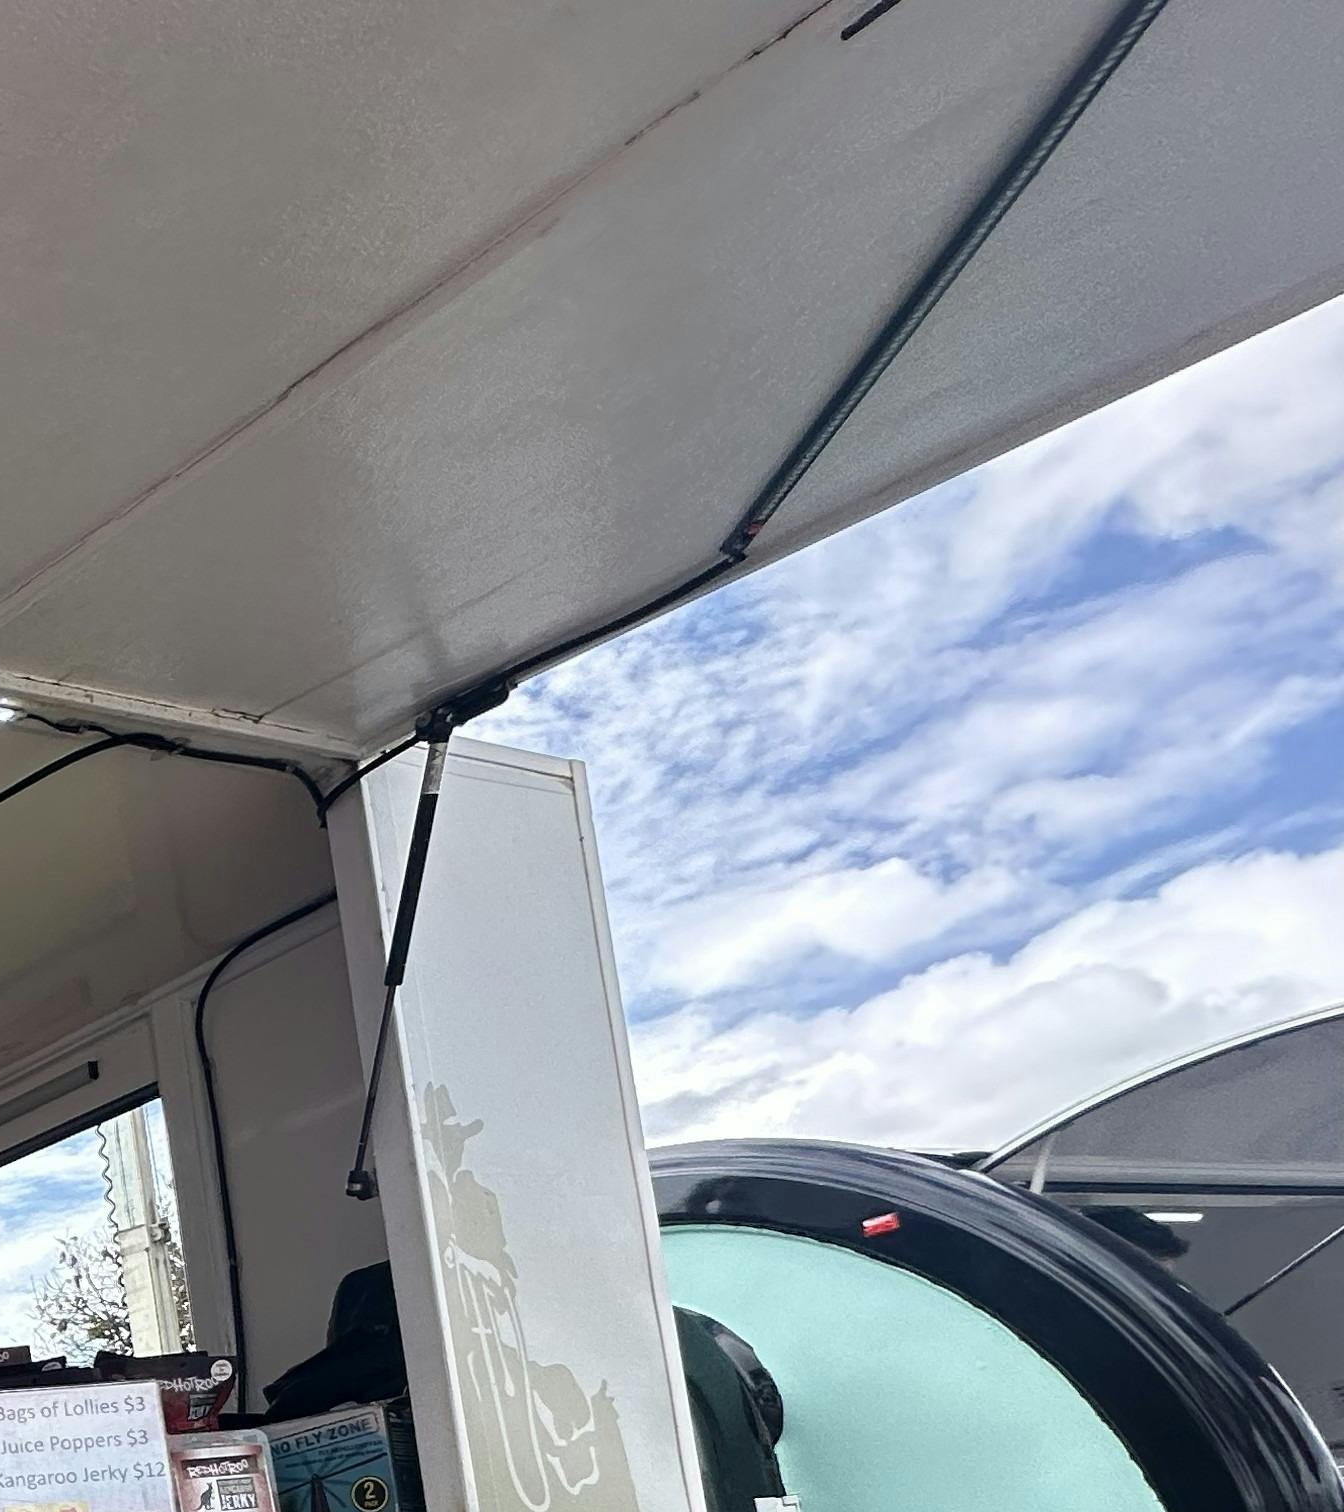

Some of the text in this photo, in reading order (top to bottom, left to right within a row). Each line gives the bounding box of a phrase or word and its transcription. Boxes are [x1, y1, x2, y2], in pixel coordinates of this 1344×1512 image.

[40, 1401, 59, 1418] of
[63, 1398, 119, 1417] Lollies
[123, 1395, 145, 1415] $3
[0, 1428, 149, 1456] Juice Poppers $3
[270, 1440, 291, 1456] NO
[294, 1431, 322, 1450] FLY
[327, 1418, 371, 1441] ZONE
[82, 1466, 129, 1486] Jerky
[132, 1462, 166, 1483] $12
[220, 1493, 257, 1510] JERKY
[363, 1481, 376, 1500] 2
